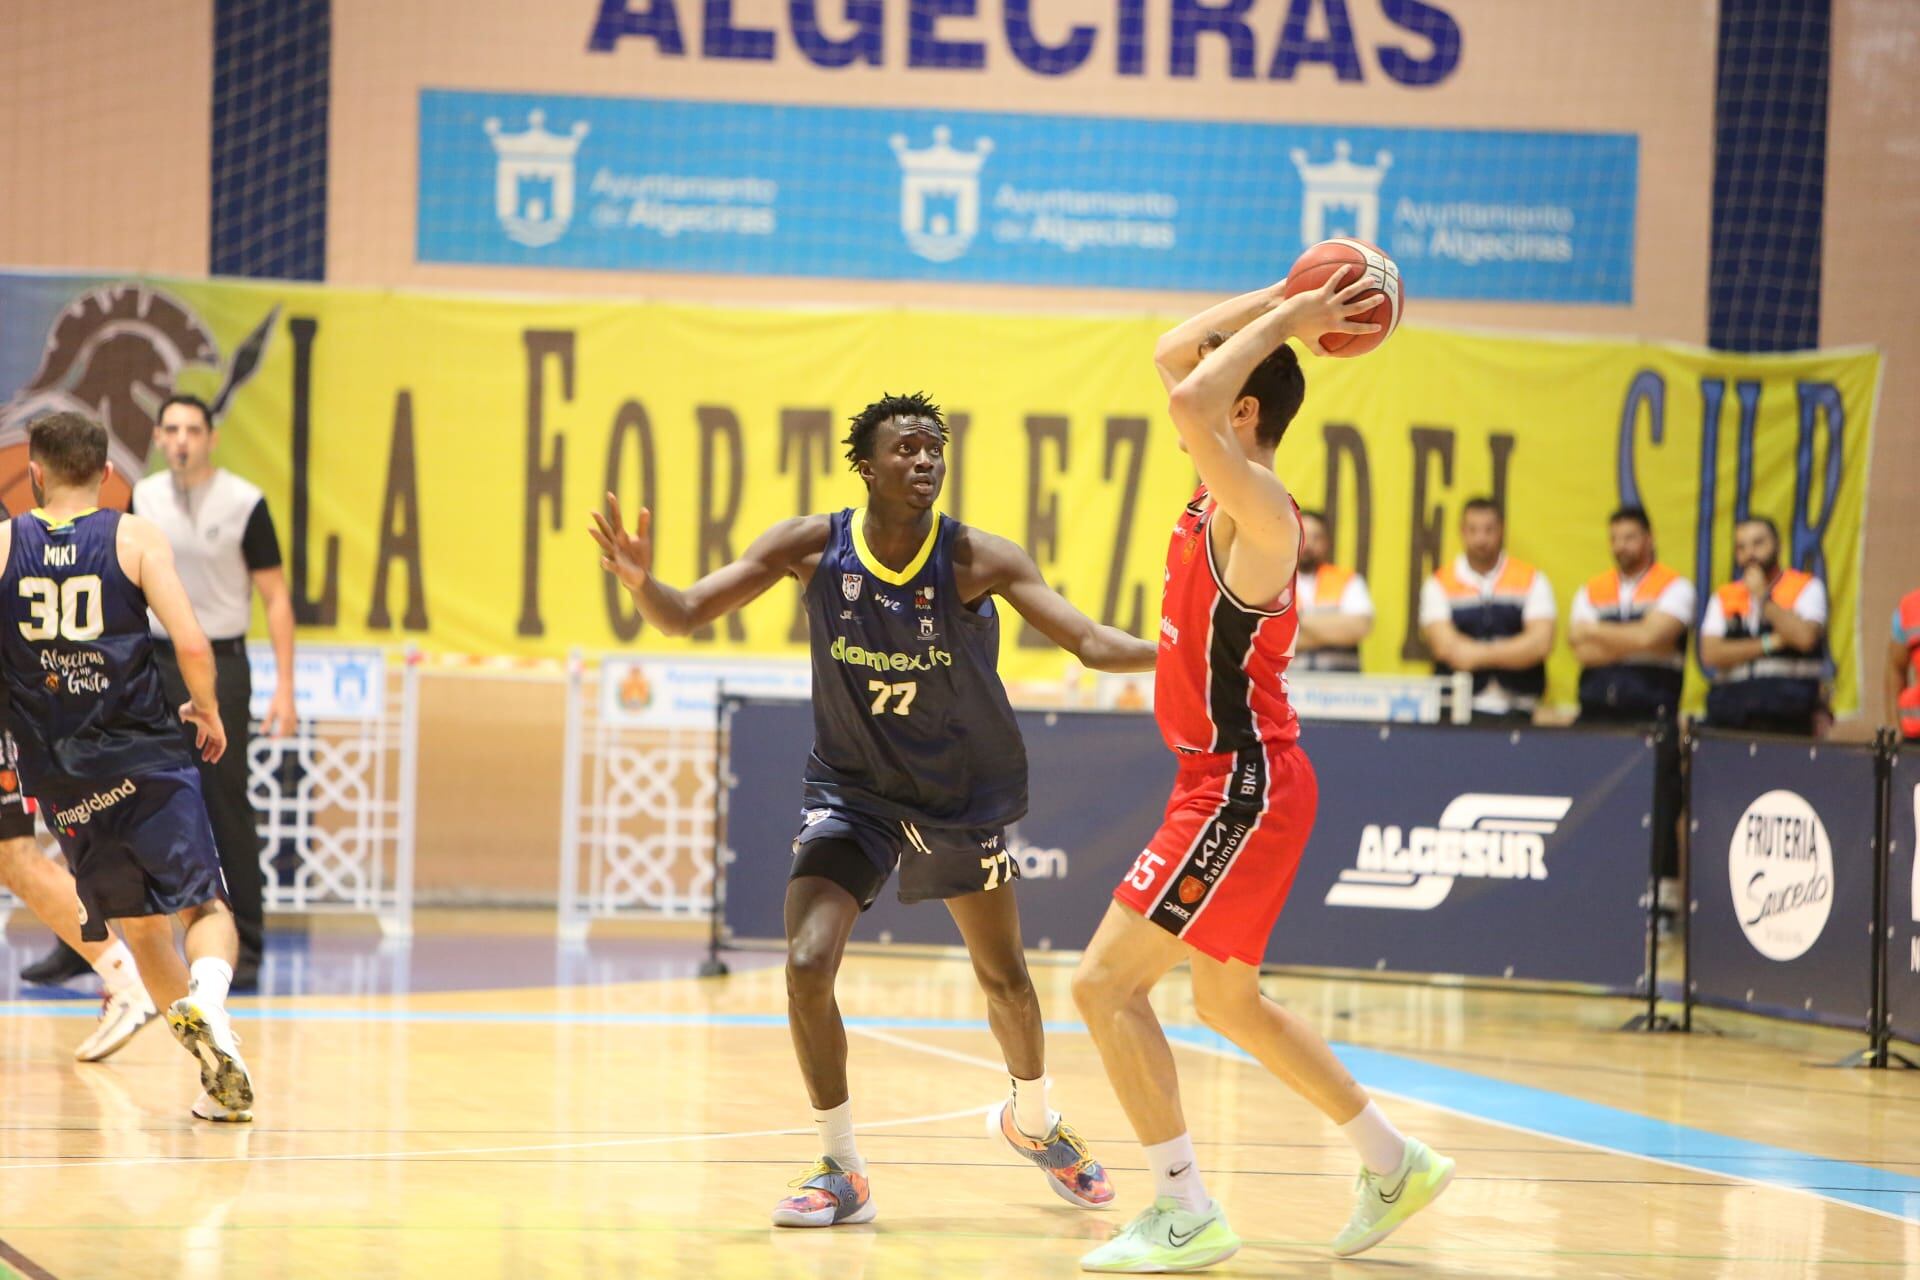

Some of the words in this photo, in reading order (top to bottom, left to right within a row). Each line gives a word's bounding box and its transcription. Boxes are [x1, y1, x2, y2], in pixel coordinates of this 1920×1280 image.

[587, 0, 1463, 86] ALGECIRAS
[590, 167, 777, 202] Ayuntamiento
[994, 184, 1177, 217] Ayuntamiento
[627, 200, 776, 237] Algeciras
[1029, 214, 1176, 252] Algeciras
[1395, 198, 1574, 232] Ayuntamiento
[1429, 227, 1573, 265] Algeciras
[516, 329, 1150, 650] FORTEZ
[44, 544, 77, 567] MIKI
[18, 575, 105, 642] 30
[868, 679, 918, 717] 77
[55, 778, 137, 827] magicland
